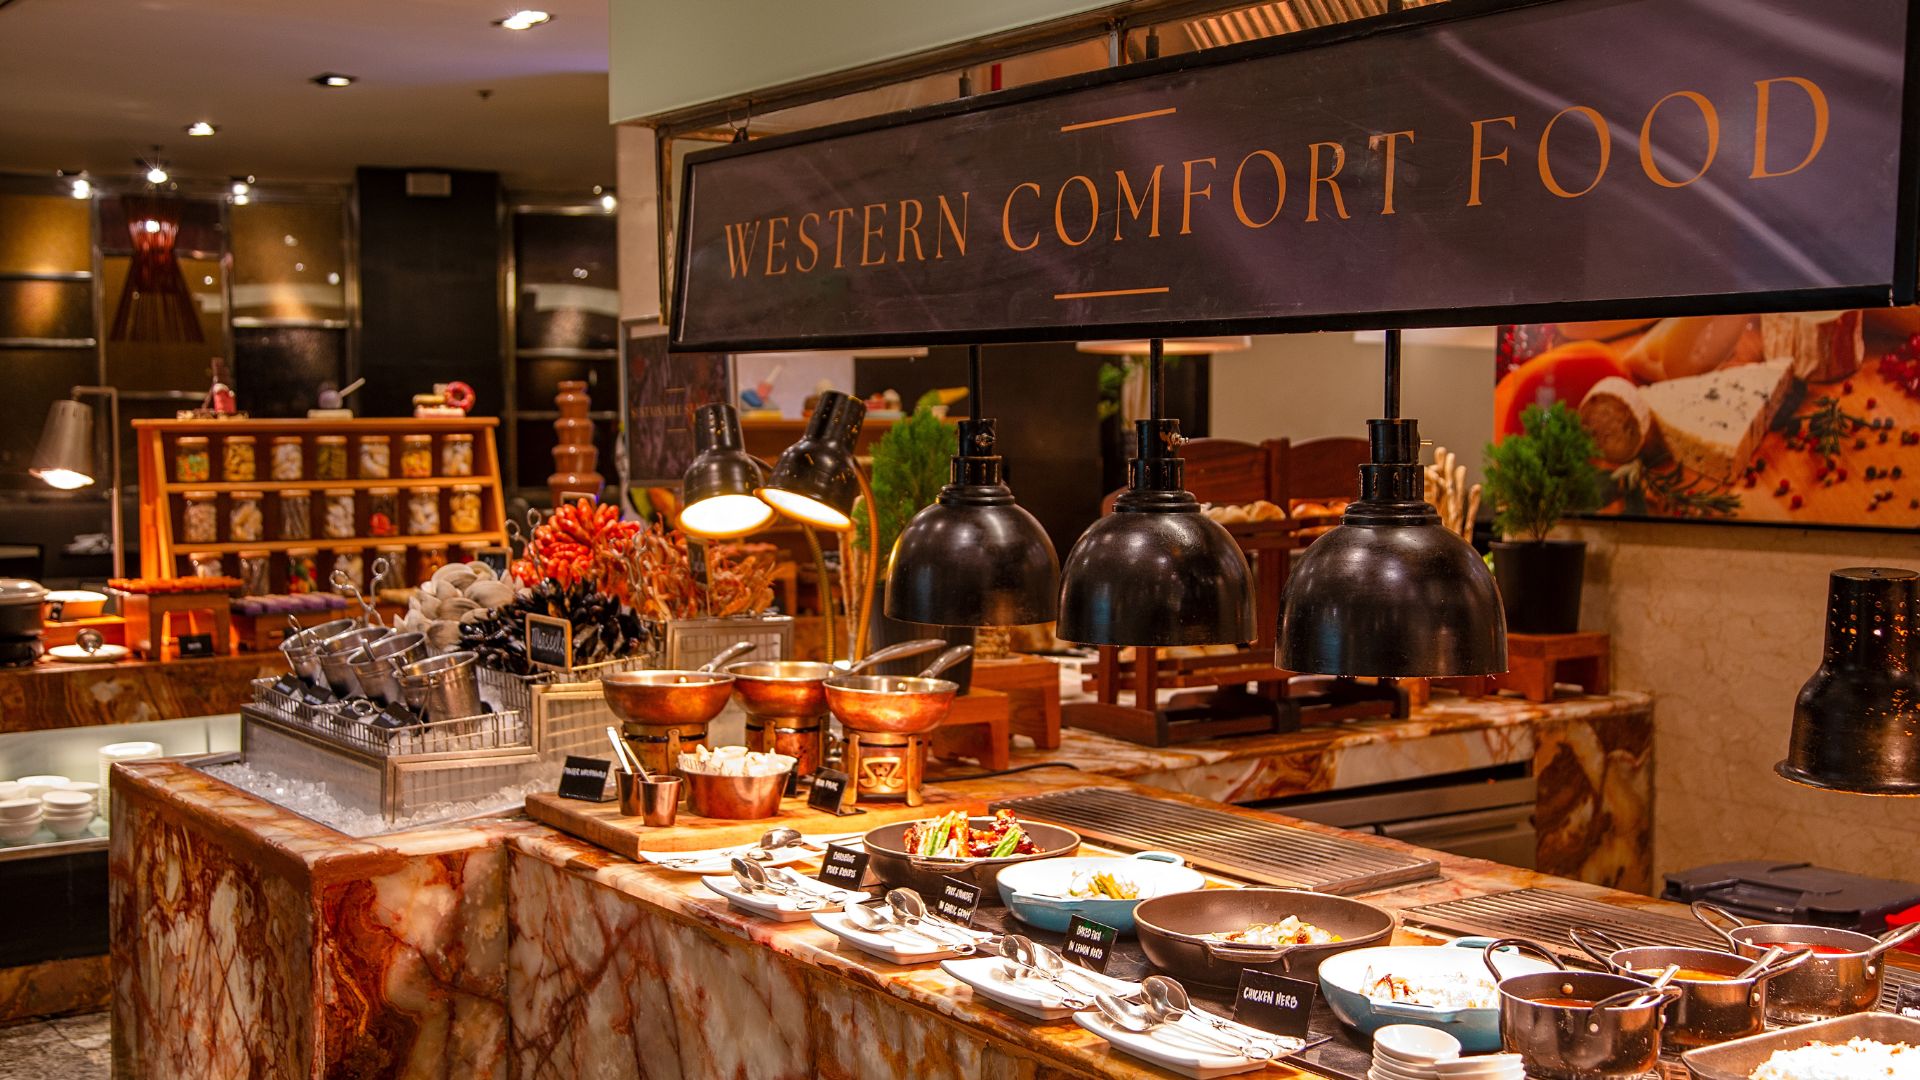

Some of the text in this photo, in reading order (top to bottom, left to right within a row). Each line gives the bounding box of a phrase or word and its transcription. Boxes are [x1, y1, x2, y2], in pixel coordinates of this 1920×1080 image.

[725, 76, 1830, 279] WESTERN COMFORT FOOD
[1068, 939, 1076, 951] IN
[1074, 942, 1090, 956] LEMON
[1243, 986, 1298, 1009] CHICKEN HERB
